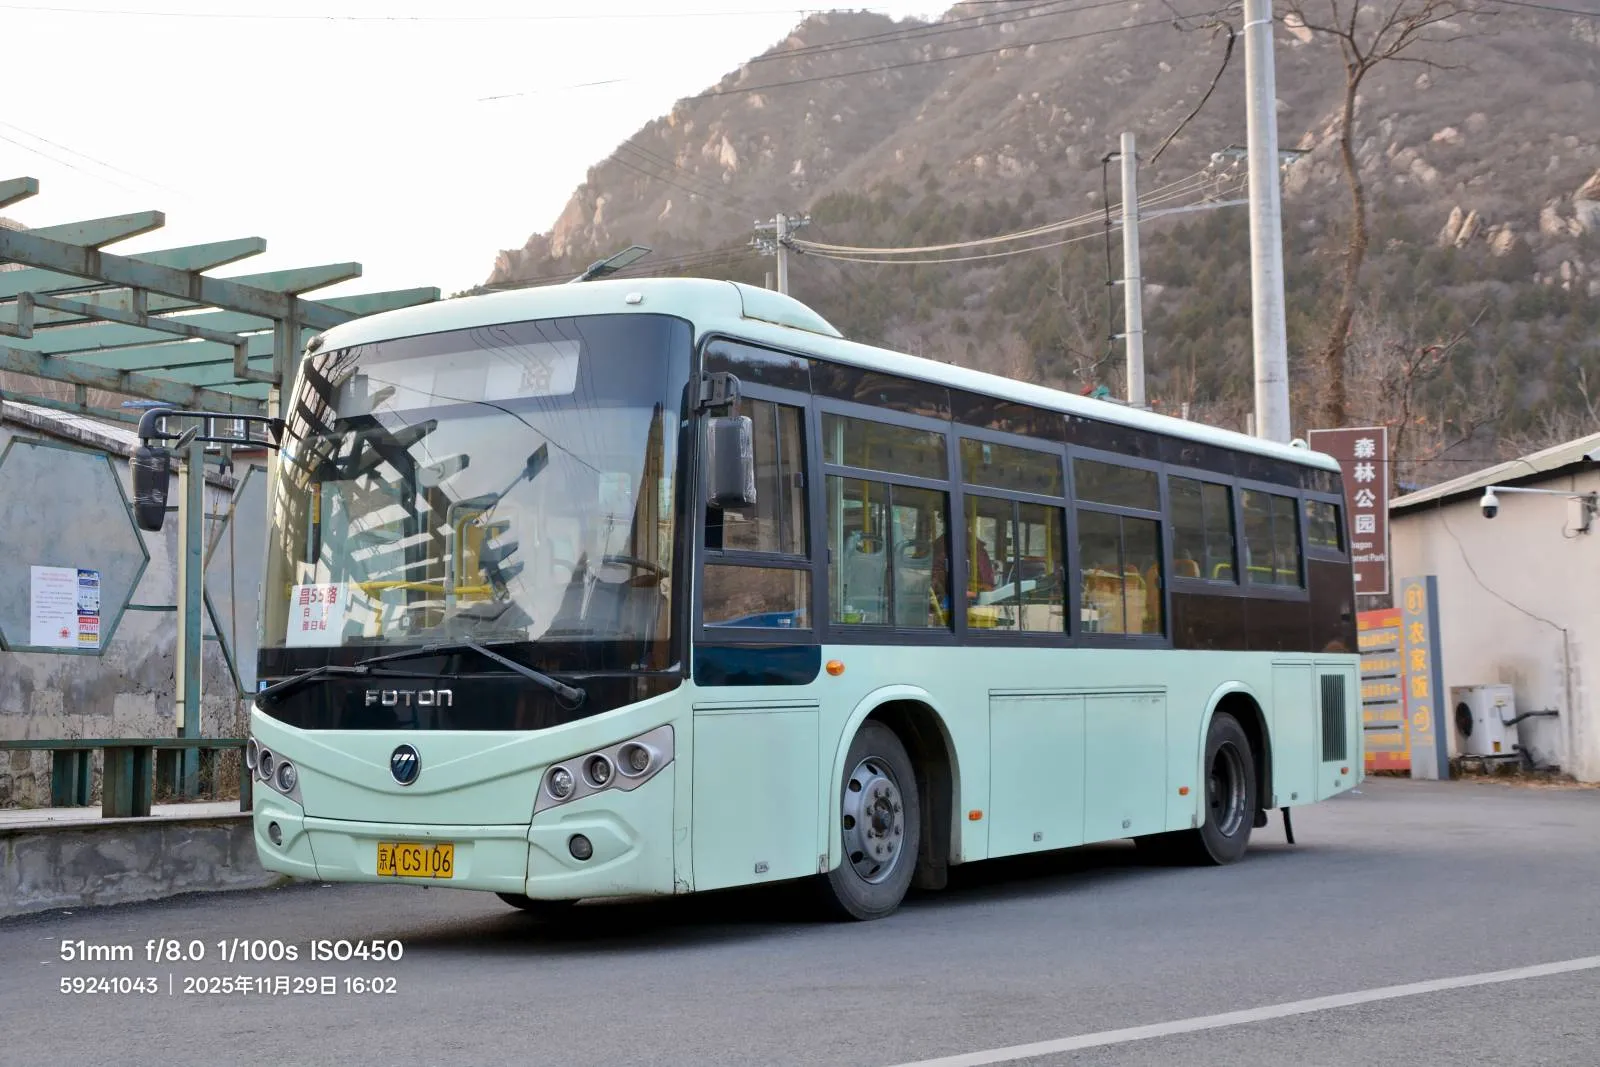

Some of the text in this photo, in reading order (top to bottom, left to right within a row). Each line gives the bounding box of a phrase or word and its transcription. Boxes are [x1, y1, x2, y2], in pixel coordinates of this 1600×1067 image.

[1353, 437, 1377, 534] 森林公园
[365, 689, 452, 706] FOTON
[1408, 621, 1429, 699] 农家饭
